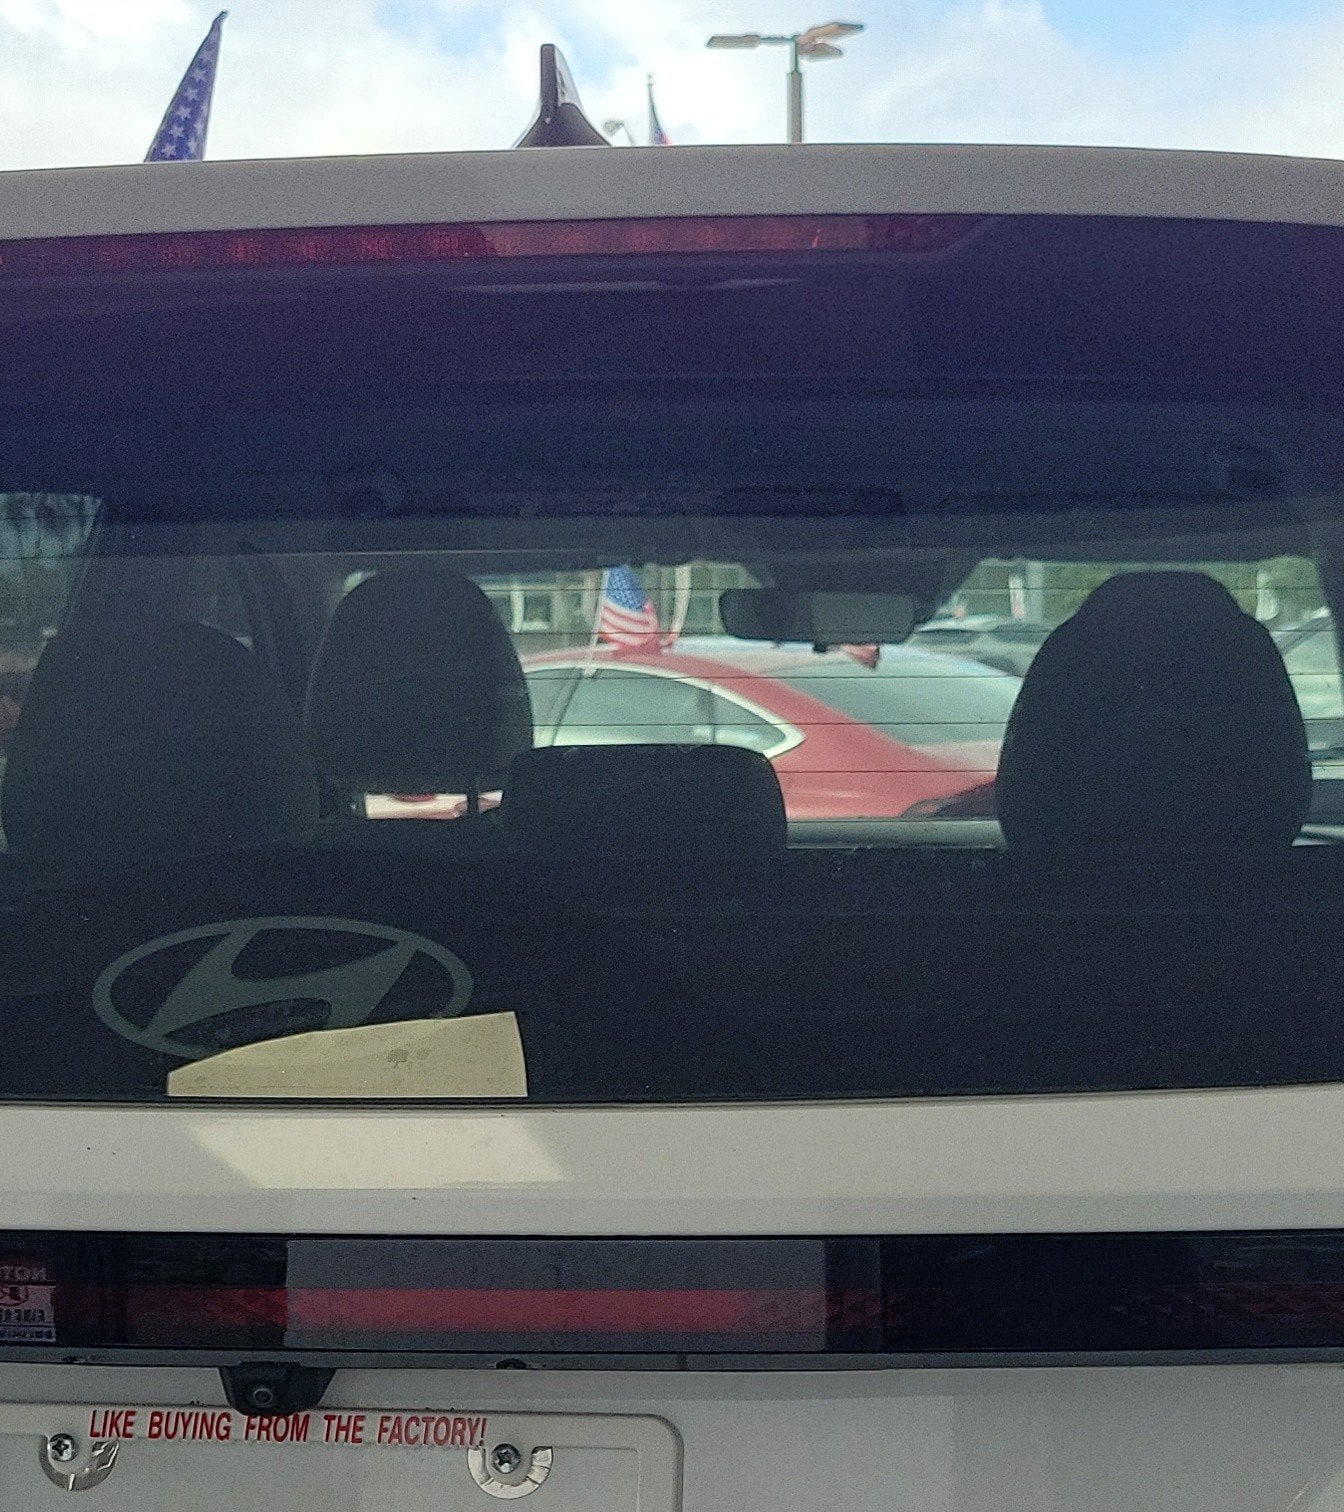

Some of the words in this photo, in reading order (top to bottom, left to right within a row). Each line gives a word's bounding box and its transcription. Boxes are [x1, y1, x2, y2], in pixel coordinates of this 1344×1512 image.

[89, 1410, 135, 1439] LIKE
[147, 1411, 231, 1441] BUYING
[245, 1414, 310, 1441] FROM
[325, 1414, 364, 1444] THE
[377, 1416, 487, 1447] FACTORY!
